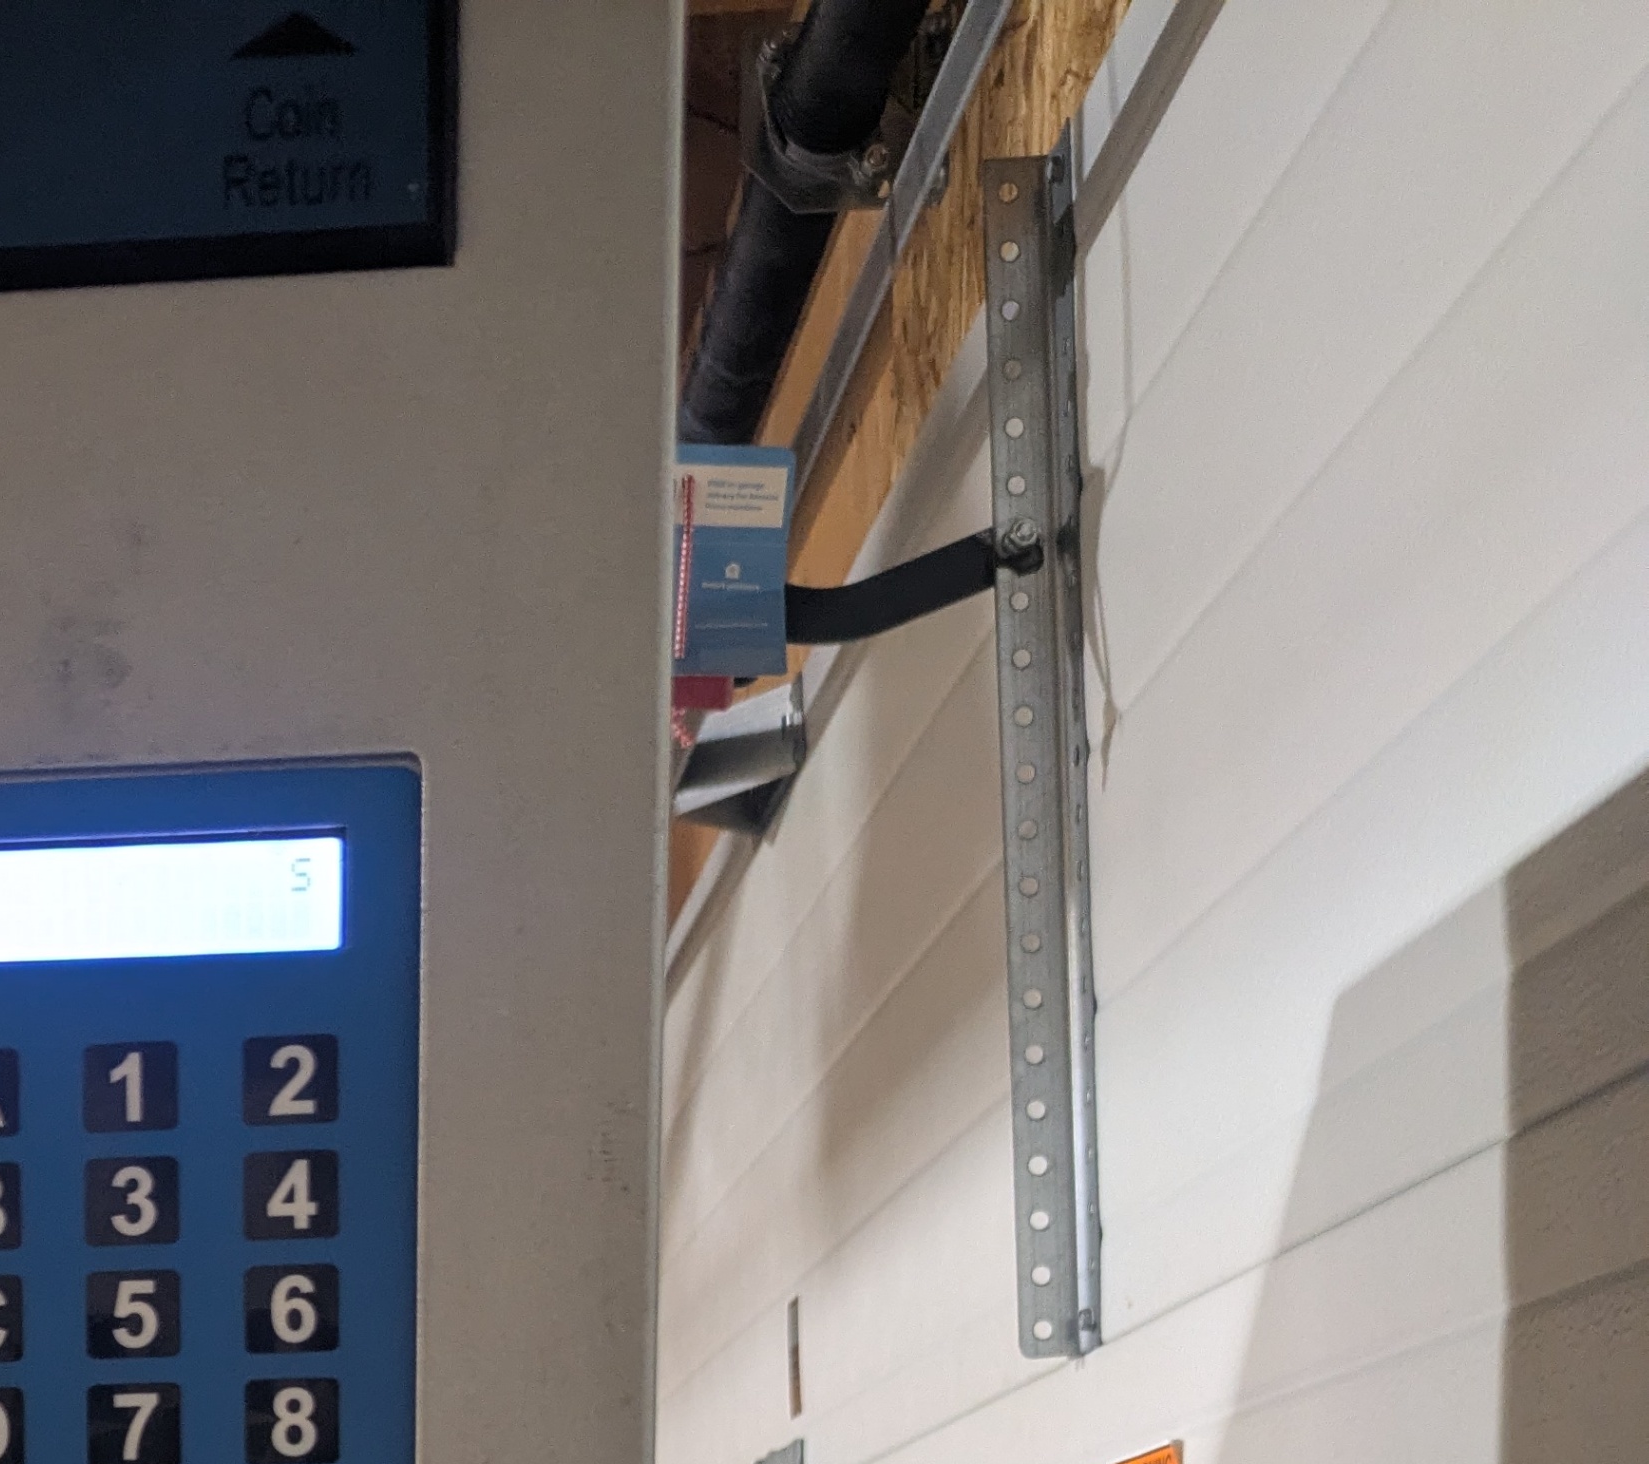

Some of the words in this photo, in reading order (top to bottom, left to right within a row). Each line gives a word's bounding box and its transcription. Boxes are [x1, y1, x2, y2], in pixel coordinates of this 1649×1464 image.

[243, 86, 343, 142] Coin
[222, 154, 373, 207] Return
[110, 1053, 142, 1121] 1
[269, 1045, 315, 1115] 2
[111, 1166, 157, 1235] 3
[267, 1160, 317, 1228] 4
[113, 1280, 158, 1348] 5
[270, 1275, 316, 1343] 6
[113, 1393, 159, 1461] 7
[271, 1388, 317, 1456] 8
